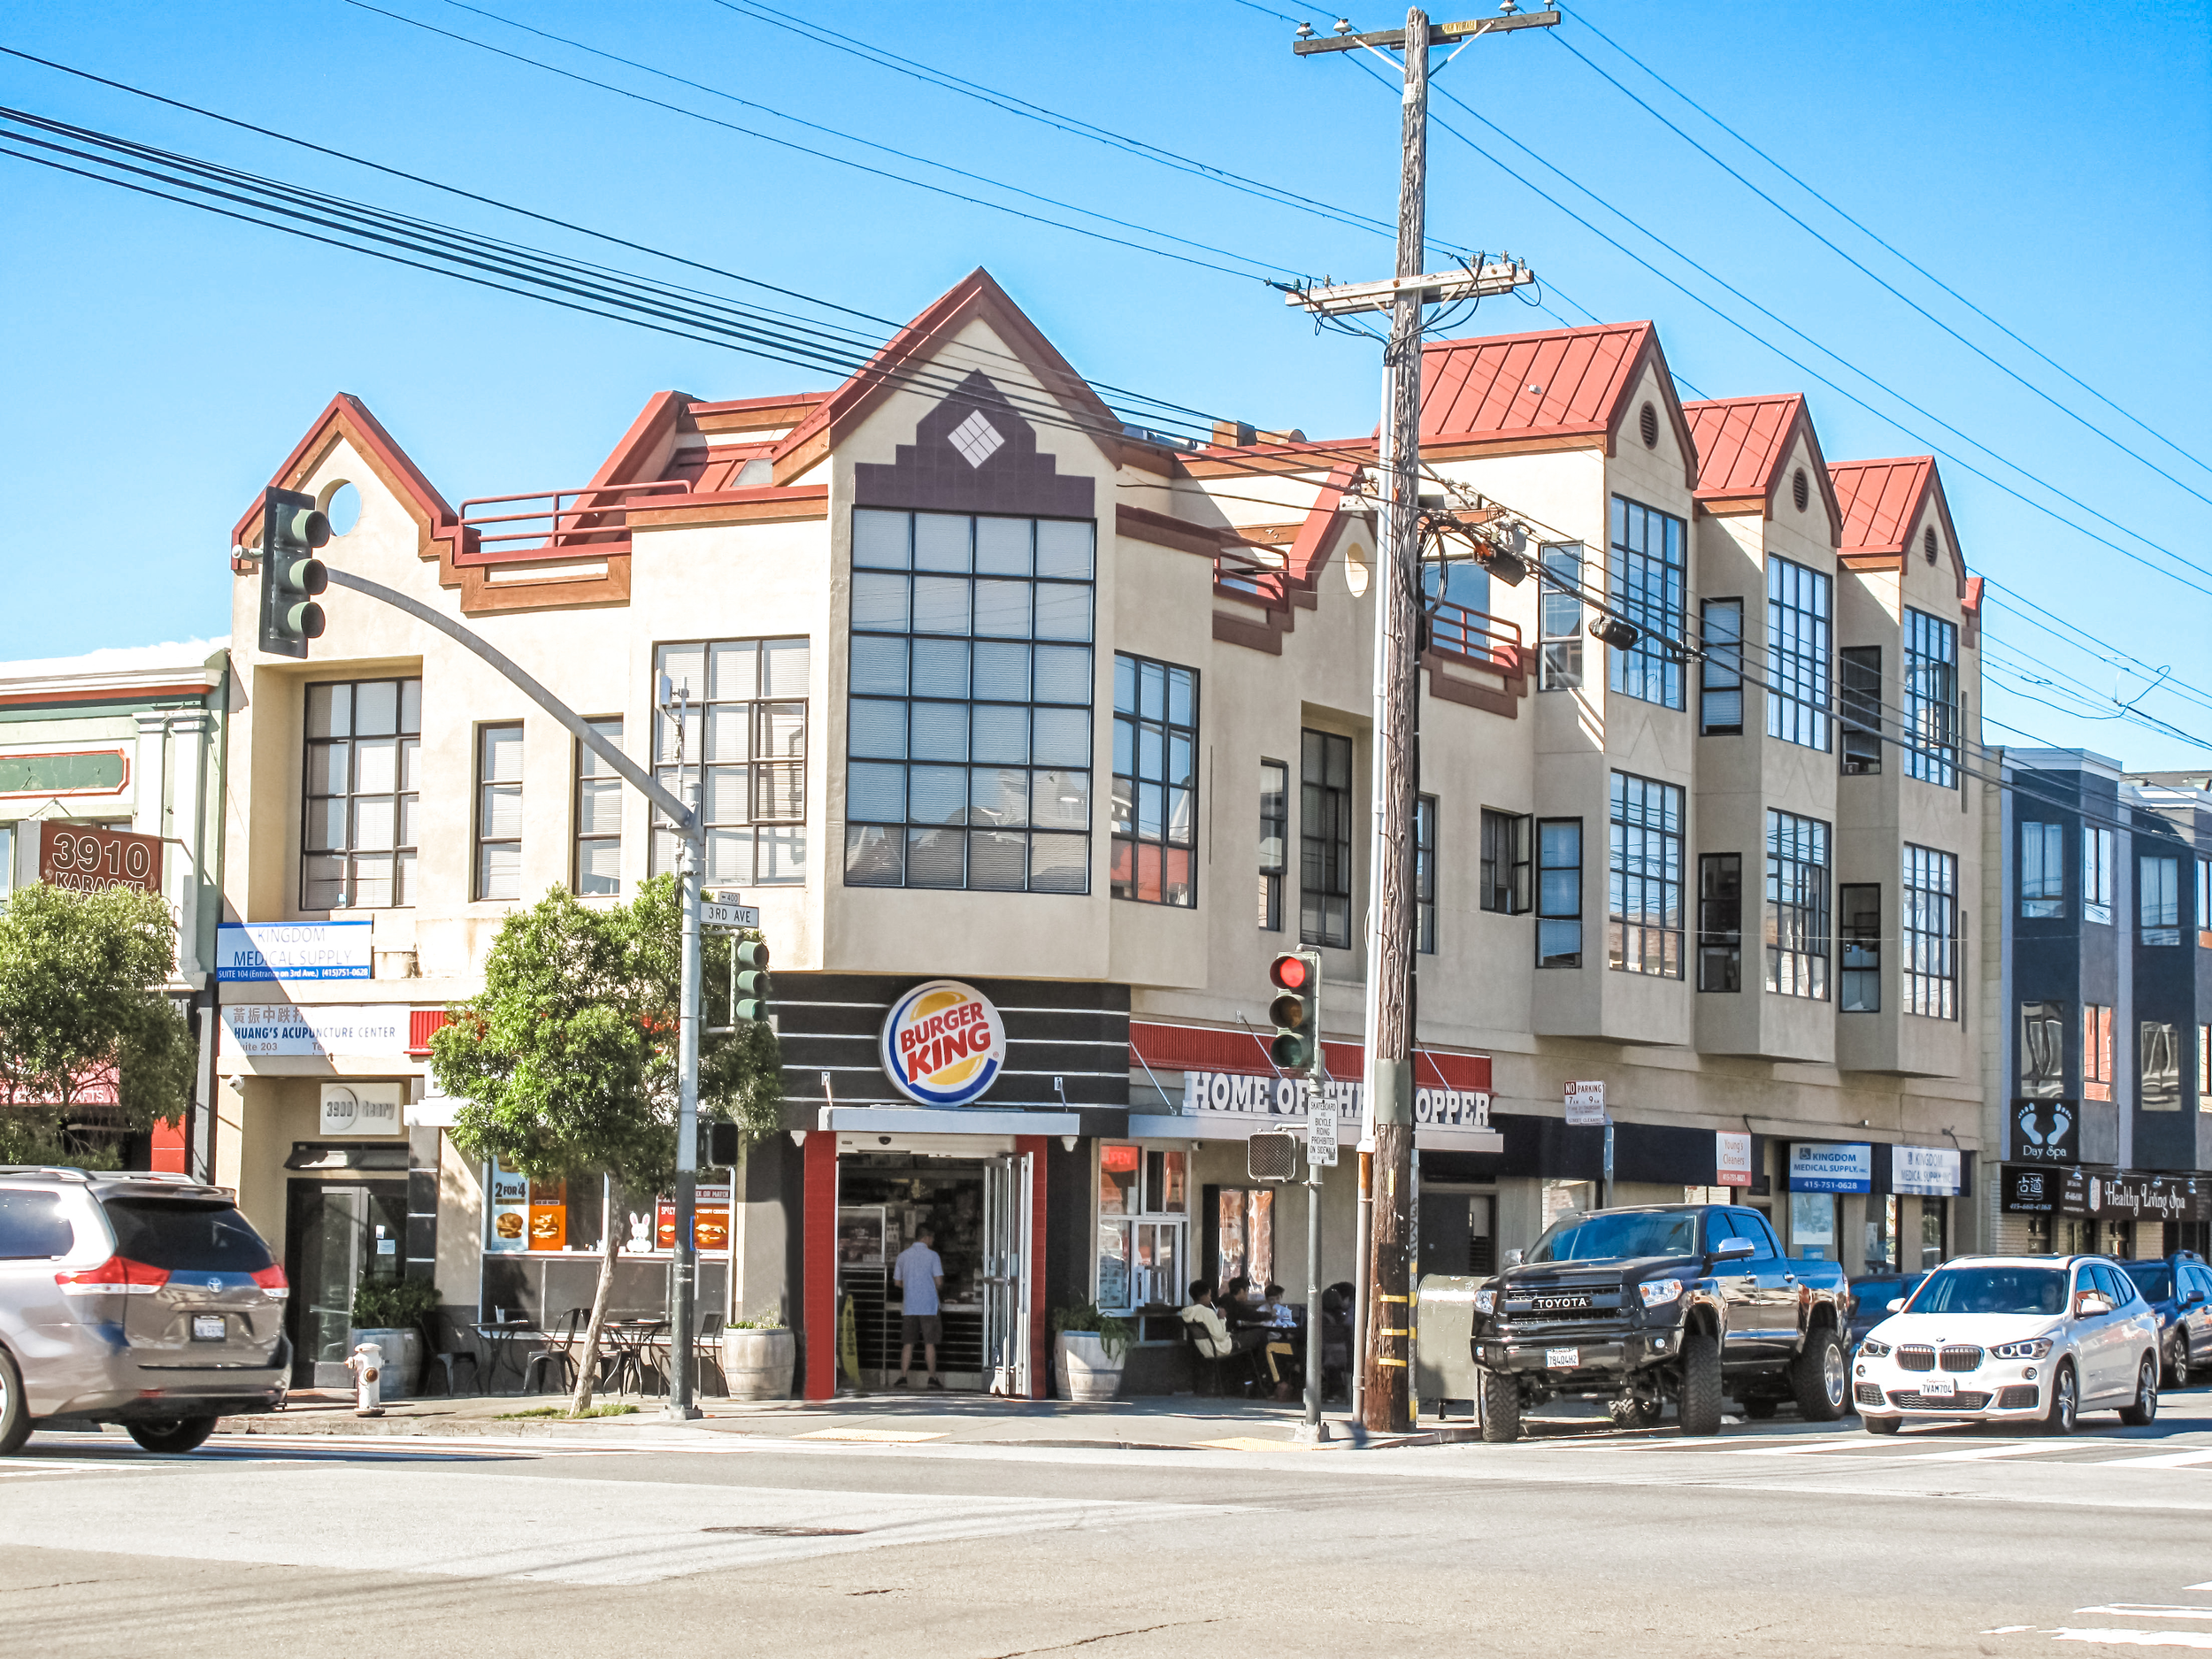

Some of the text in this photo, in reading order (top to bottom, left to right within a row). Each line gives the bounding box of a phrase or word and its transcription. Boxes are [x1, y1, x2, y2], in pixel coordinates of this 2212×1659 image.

[52, 833, 150, 879] 3910
[726, 894, 739, 902] 400
[709, 907, 751, 924] 3RD AVE
[257, 927, 326, 943] KINGDOM
[234, 949, 353, 967] MEDICAL SUPPLY
[219, 970, 236, 979] SUITE
[250, 970, 280, 979] (Entrance
[289, 969, 302, 978] 3rd
[234, 1026, 396, 1040] HUANG'S ACUPUNCTURE CENTER
[900, 1002, 985, 1054] BURGER
[241, 1041, 257, 1051] uite
[260, 1042, 278, 1051] 203
[907, 1021, 991, 1083] KING
[1566, 1083, 1575, 1094] NO
[1187, 1071, 1271, 1113] HOME
[1276, 1077, 1310, 1116] OF
[1416, 1087, 1490, 1127] OPPER
[326, 1101, 354, 1118] 3900
[1310, 1102, 1336, 1111] SKATEBOARD
[1315, 1118, 1332, 1127] BICYCLE
[1316, 1127, 1331, 1137] RIDING
[1310, 1136, 1335, 1146] PROHIBITED
[1724, 1139, 1744, 1154] Young's
[1723, 1154, 1745, 1165] Cleaners
[1812, 1153, 1856, 1162] KINGDOM
[2023, 1145, 2067, 1160] Day Spa
[1915, 1153, 1943, 1168] KINGDOM
[495, 1182, 503, 1198] 2
[503, 1186, 517, 1195] FOR
[1804, 1180, 1857, 1189] 415-751-0628
[2105, 1181, 2139, 1217] Healthy
[2140, 1183, 2169, 1218] Living
[2169, 1185, 2185, 1218] Spa
[661, 1207, 675, 1216] SPICY
[1538, 1298, 1587, 1309] TOYOTA
